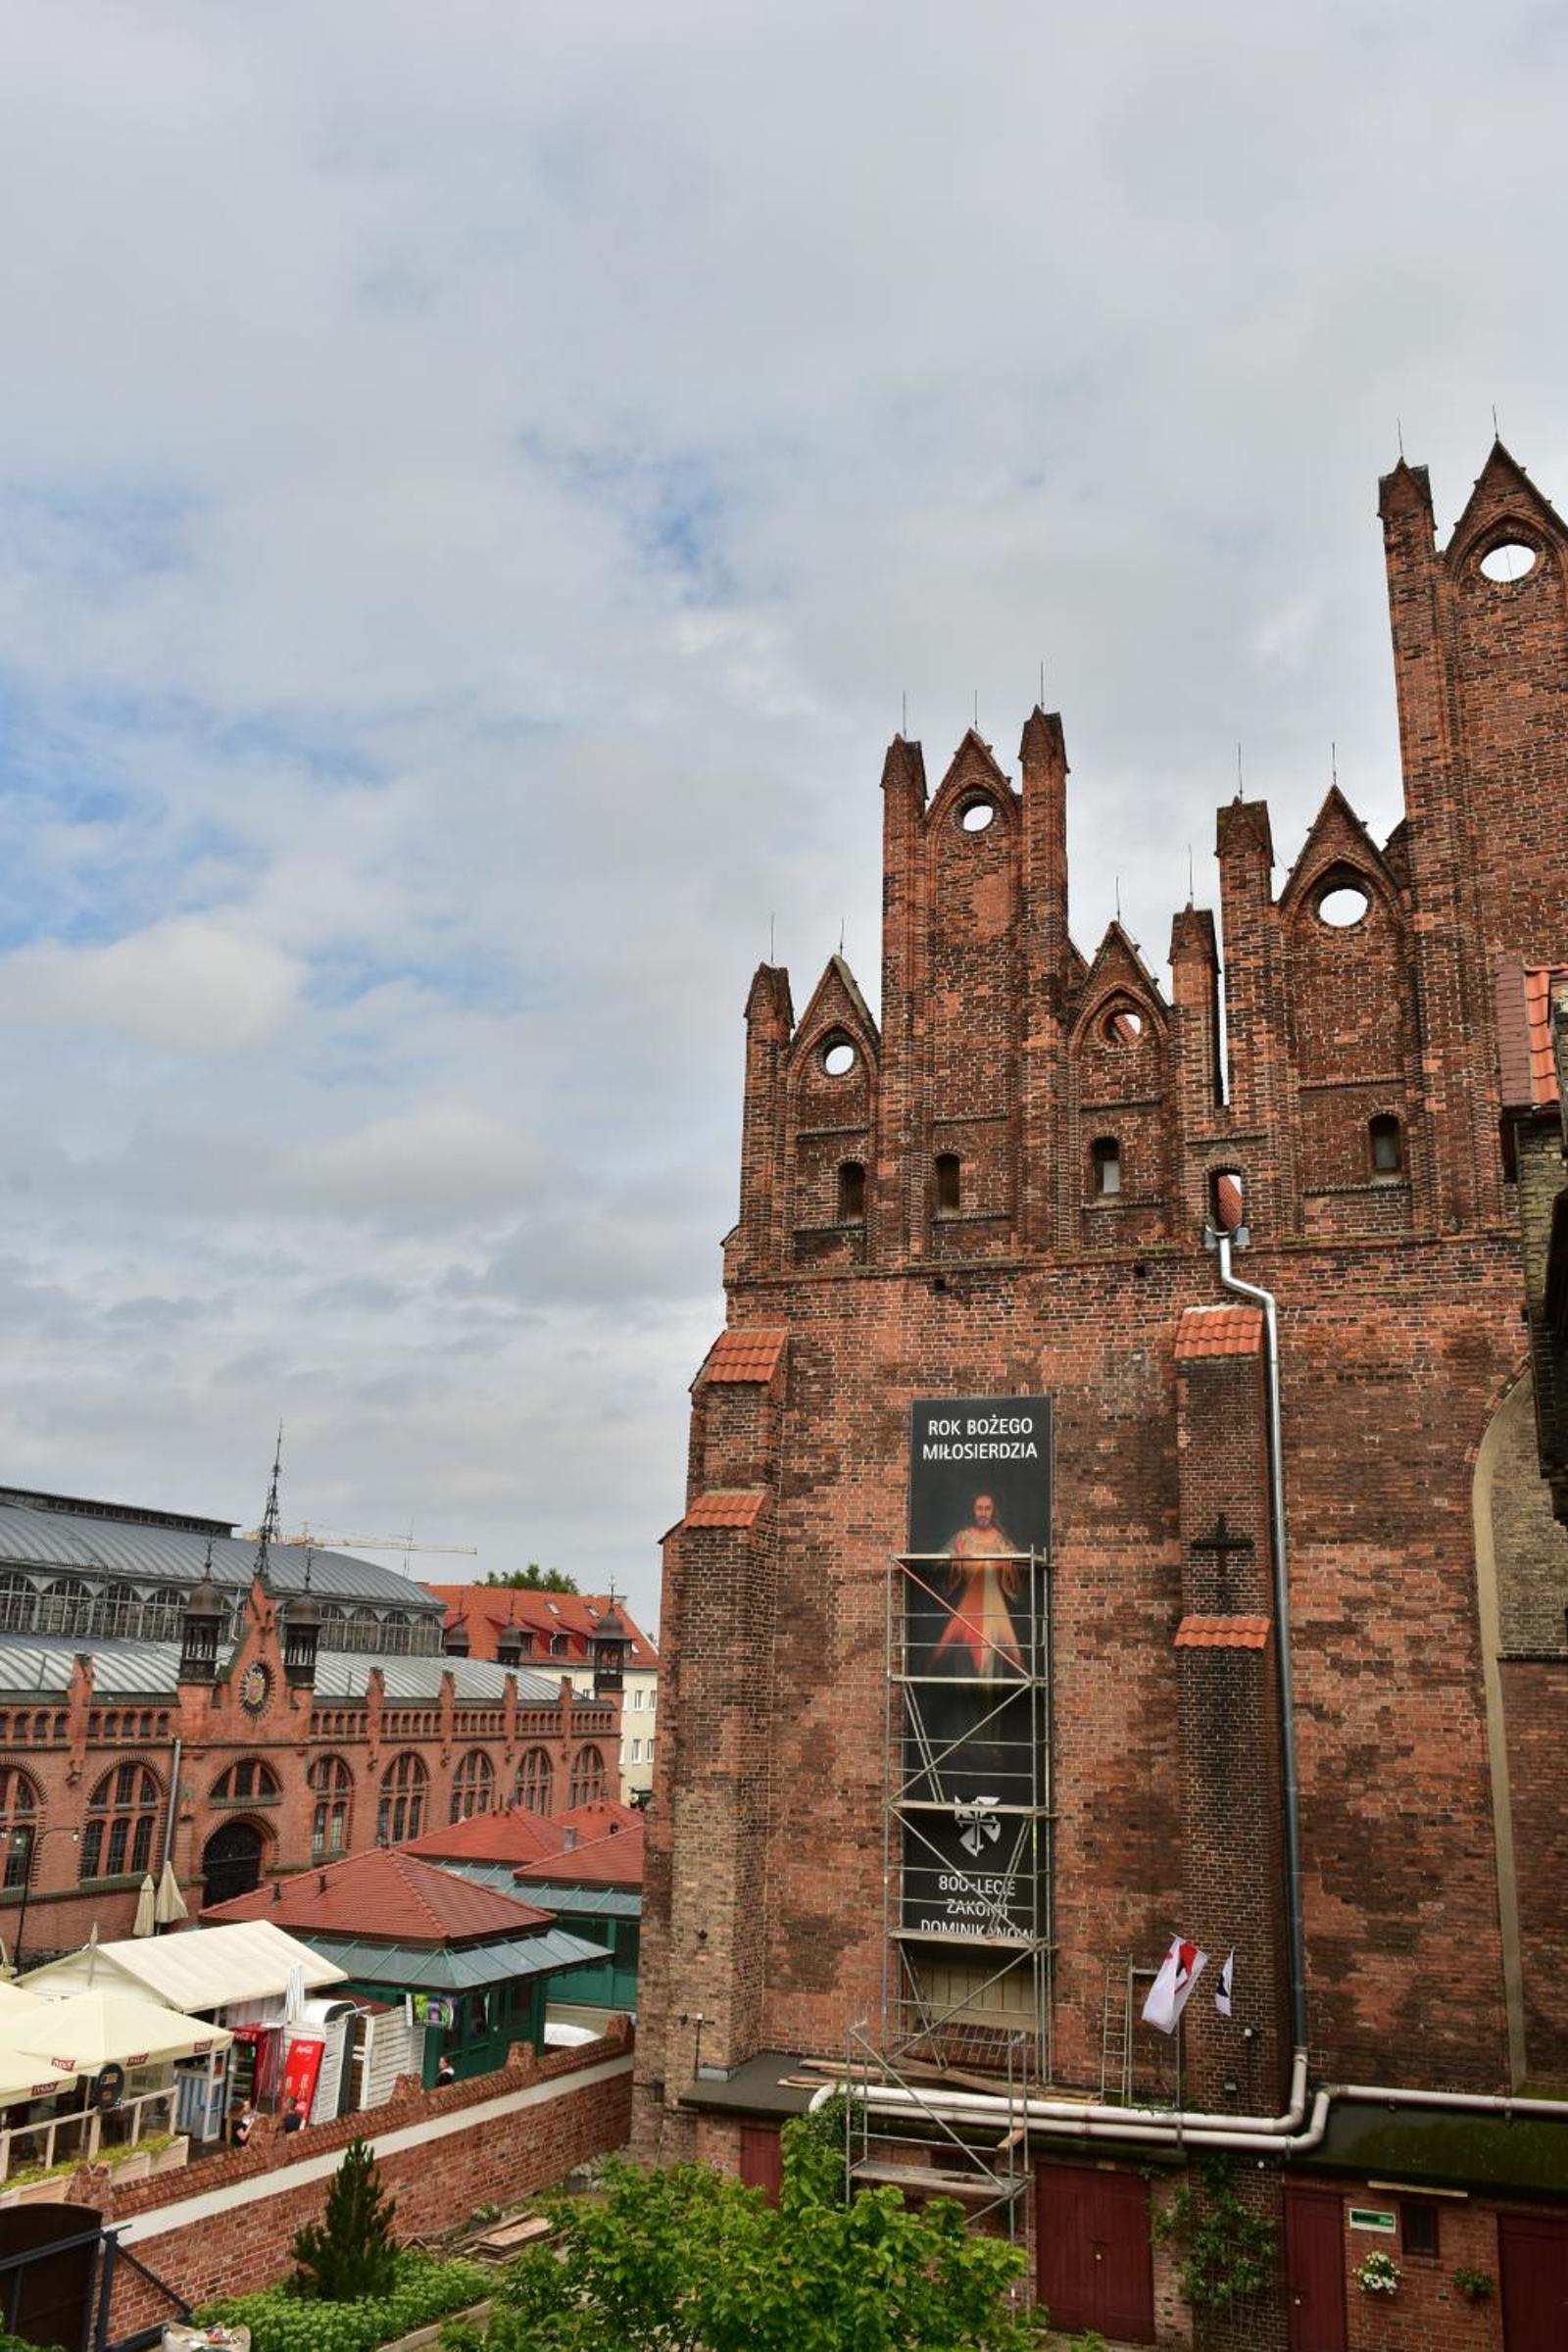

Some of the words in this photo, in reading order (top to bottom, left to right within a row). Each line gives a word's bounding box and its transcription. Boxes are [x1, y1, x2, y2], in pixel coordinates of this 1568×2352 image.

[928, 1419, 961, 1436] ROK
[966, 1413, 1033, 1435] BOŻEGO
[922, 1442, 1038, 1460] MIŁOSIERDZIA
